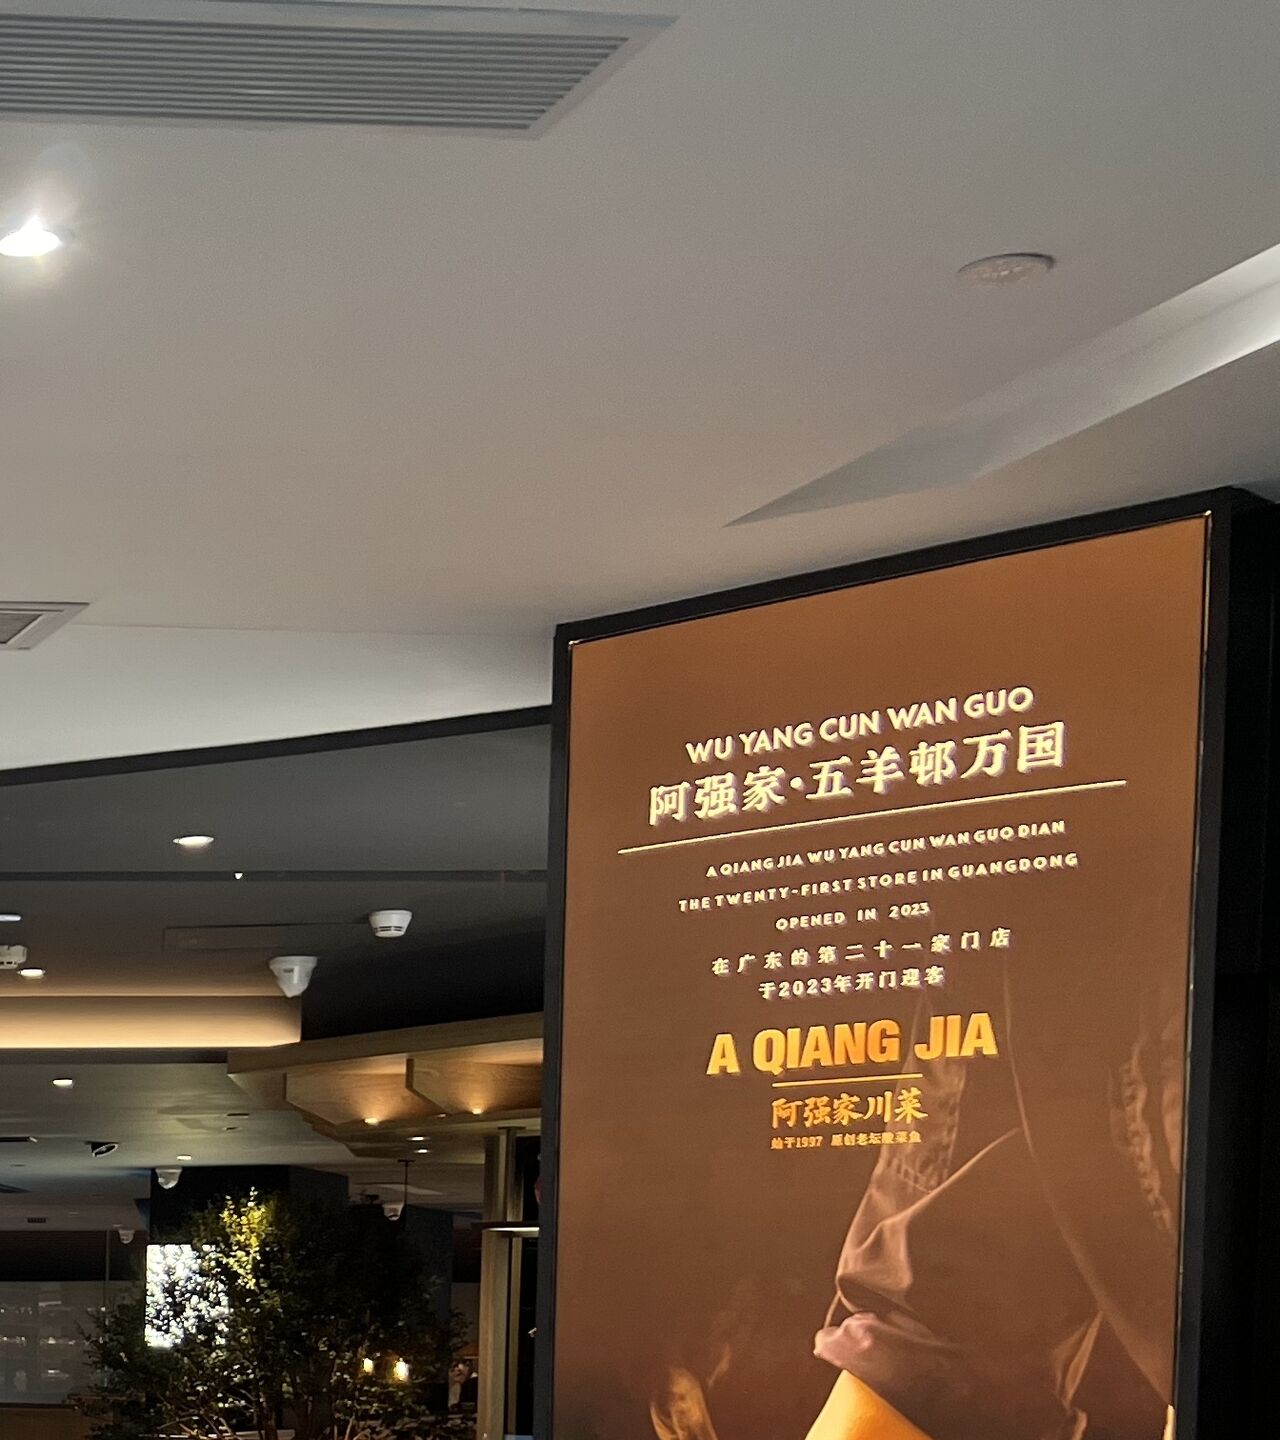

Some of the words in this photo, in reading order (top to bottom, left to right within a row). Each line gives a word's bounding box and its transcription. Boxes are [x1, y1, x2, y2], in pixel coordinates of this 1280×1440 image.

[686, 735, 734, 765] WU
[739, 722, 814, 756] YANG
[819, 710, 881, 744] CUN
[887, 697, 959, 731] WAN
[963, 685, 1035, 719] GUO
[706, 865, 718, 879] A
[720, 855, 775, 877] QIANG
[777, 853, 805, 870] JIA
[807, 848, 836, 865] WU
[839, 842, 886, 861] YANG
[888, 836, 927, 855] CUN
[929, 831, 972, 849] WAN
[974, 825, 1015, 845] GUO
[1017, 820, 1067, 839] DIAN
[678, 896, 712, 913] THE
[715, 877, 854, 908] TWENTY-FIRST
[856, 870, 918, 890] STORE
[922, 866, 944, 883] IN
[946, 851, 1080, 881] GUANGDONG
[775, 910, 847, 932] OPENED
[856, 908, 878, 923] IN
[888, 901, 930, 921] 2023
[710, 927, 1013, 976] 在广东的第二十一家门店
[757, 965, 947, 1001] 于2023年开门迎客
[705, 1032, 740, 1076] A
[752, 1018, 902, 1077] QIANG
[913, 1011, 999, 1062] JIA
[771, 1086, 930, 1130] 阿强家川菜
